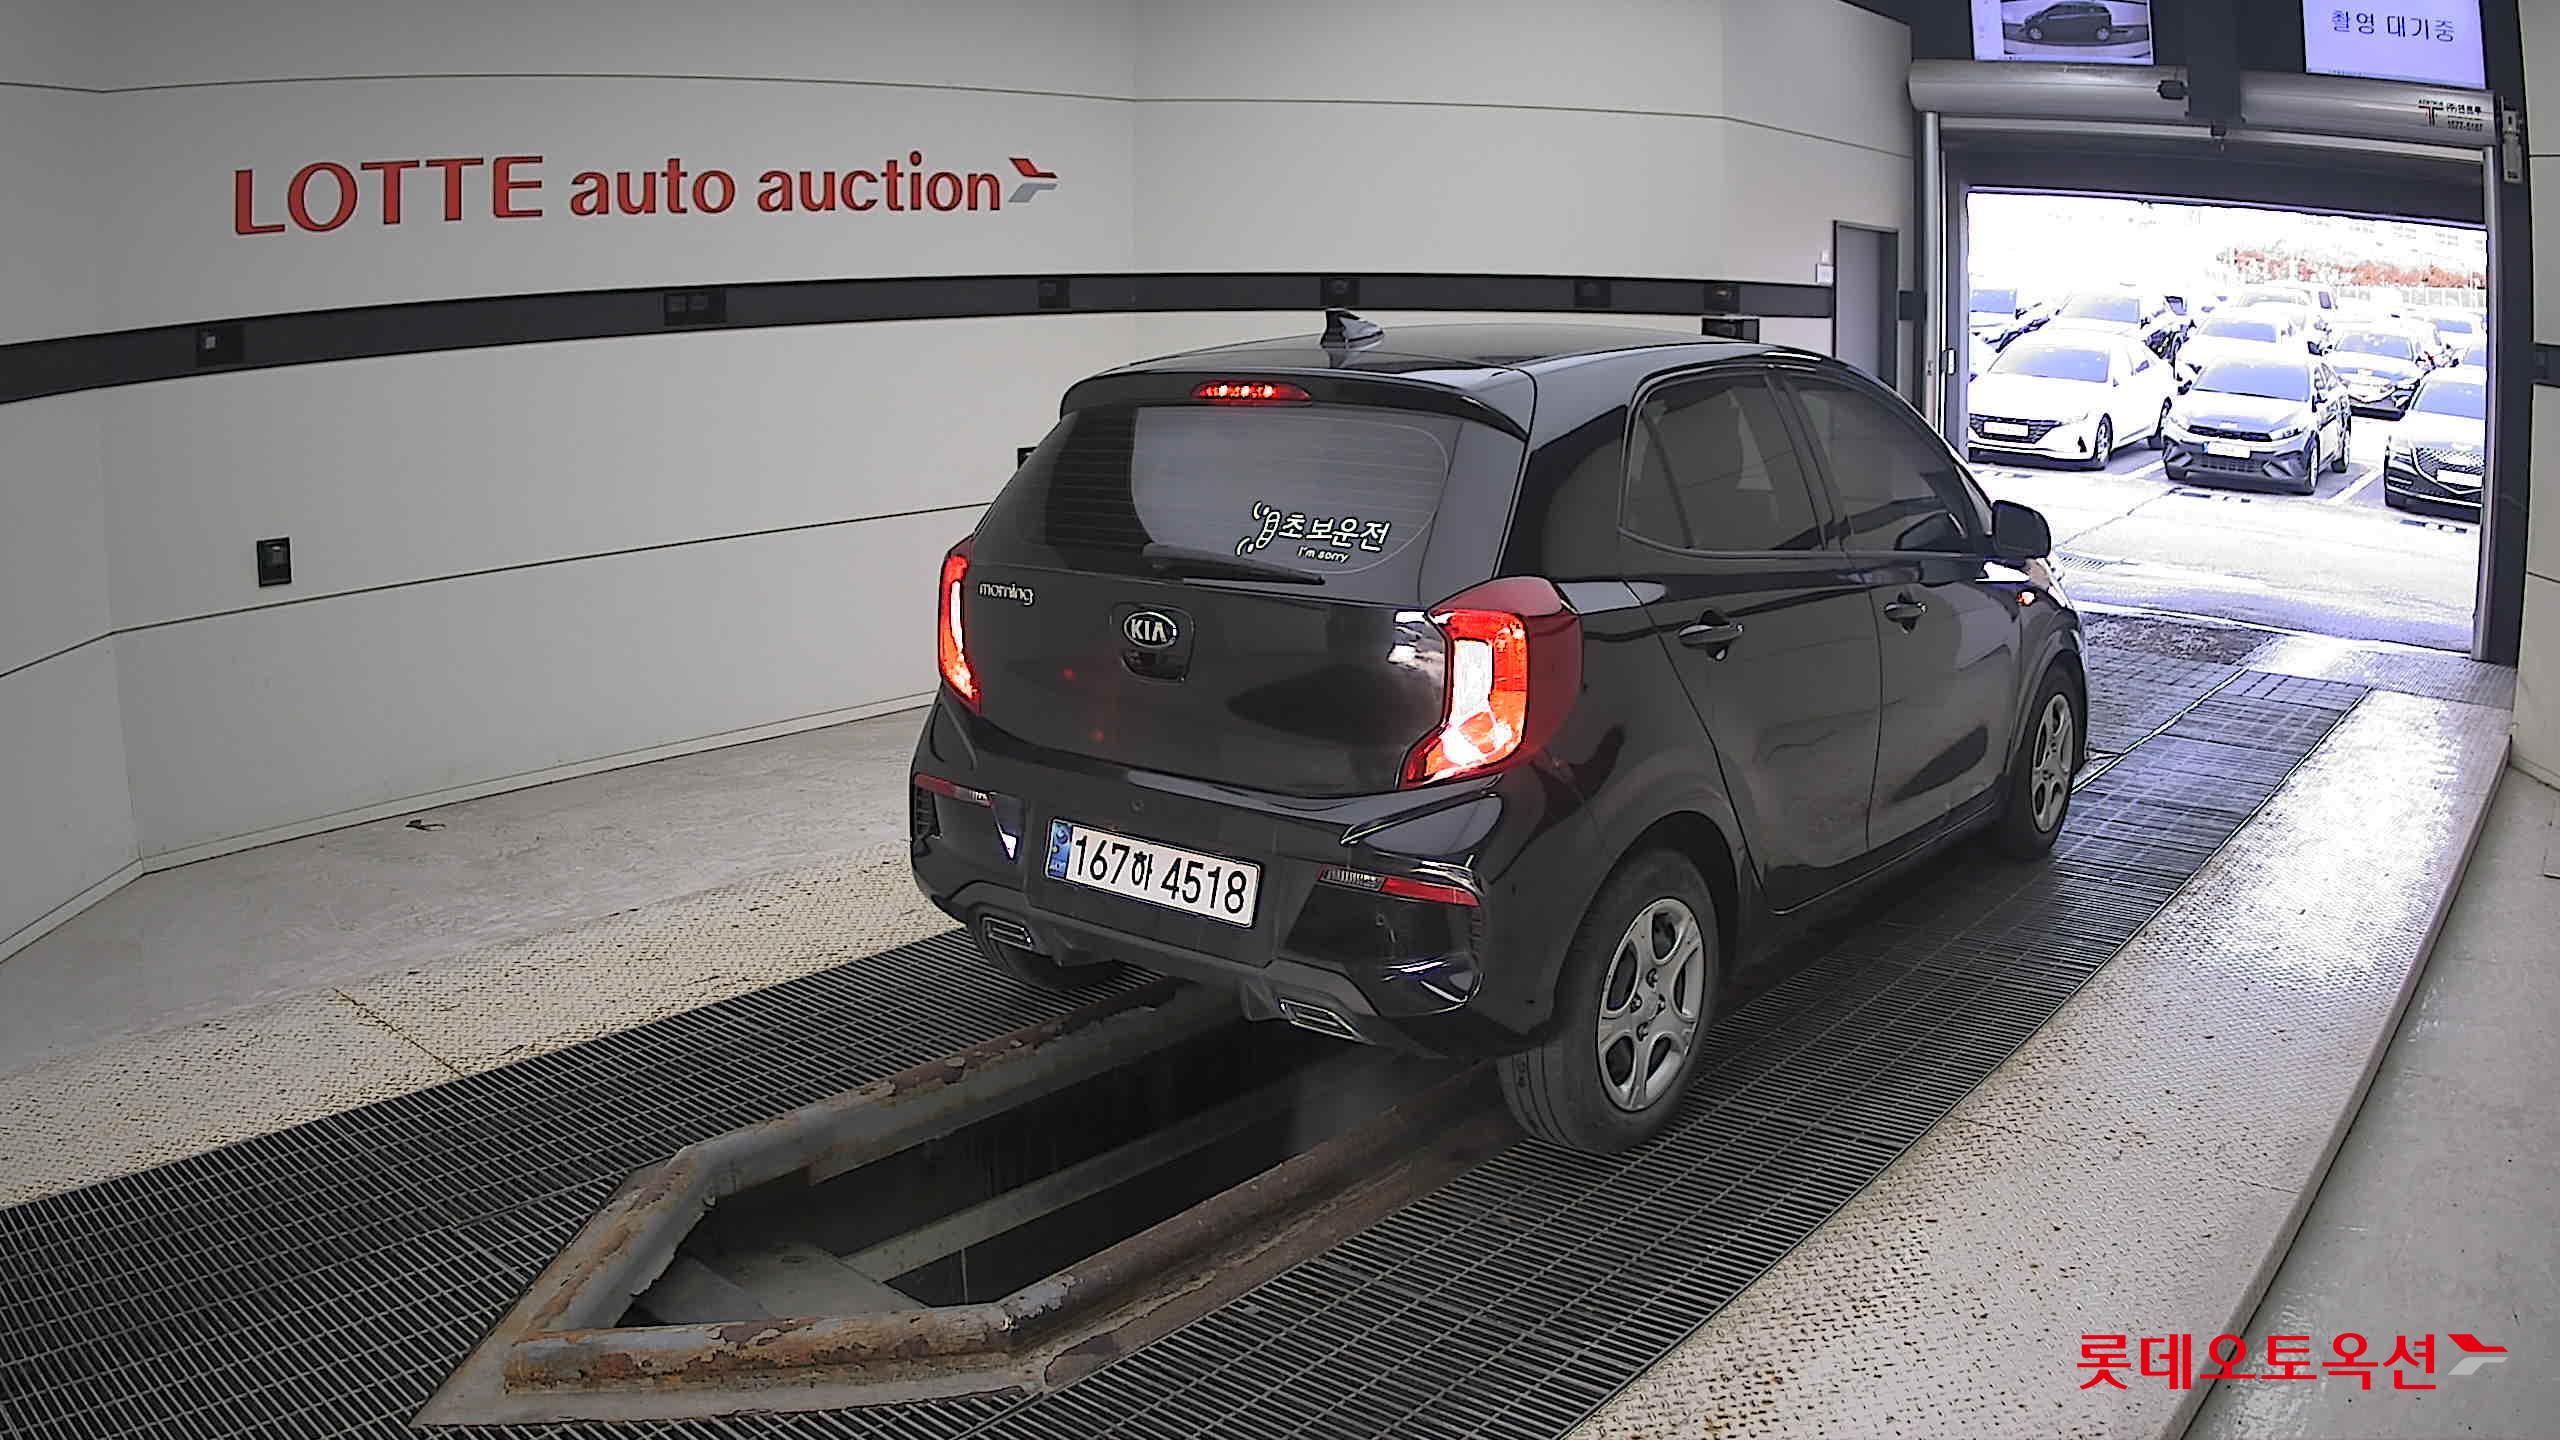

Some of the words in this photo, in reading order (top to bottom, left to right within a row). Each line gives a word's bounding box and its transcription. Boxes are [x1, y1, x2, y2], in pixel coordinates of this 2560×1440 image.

[2331, 9, 2376, 35] 촬영
[2386, 15, 2456, 43] 대기중
[235, 157, 543, 235] LOTTE
[570, 157, 736, 217] auto
[756, 151, 1001, 214] auction
[1278, 513, 1391, 552] 초보운전
[1317, 550, 1350, 563] sorry
[978, 582, 1035, 606] morning
[1130, 618, 1168, 643] KIA
[1075, 835, 1154, 891] 167하
[1160, 857, 1248, 914] 4518
